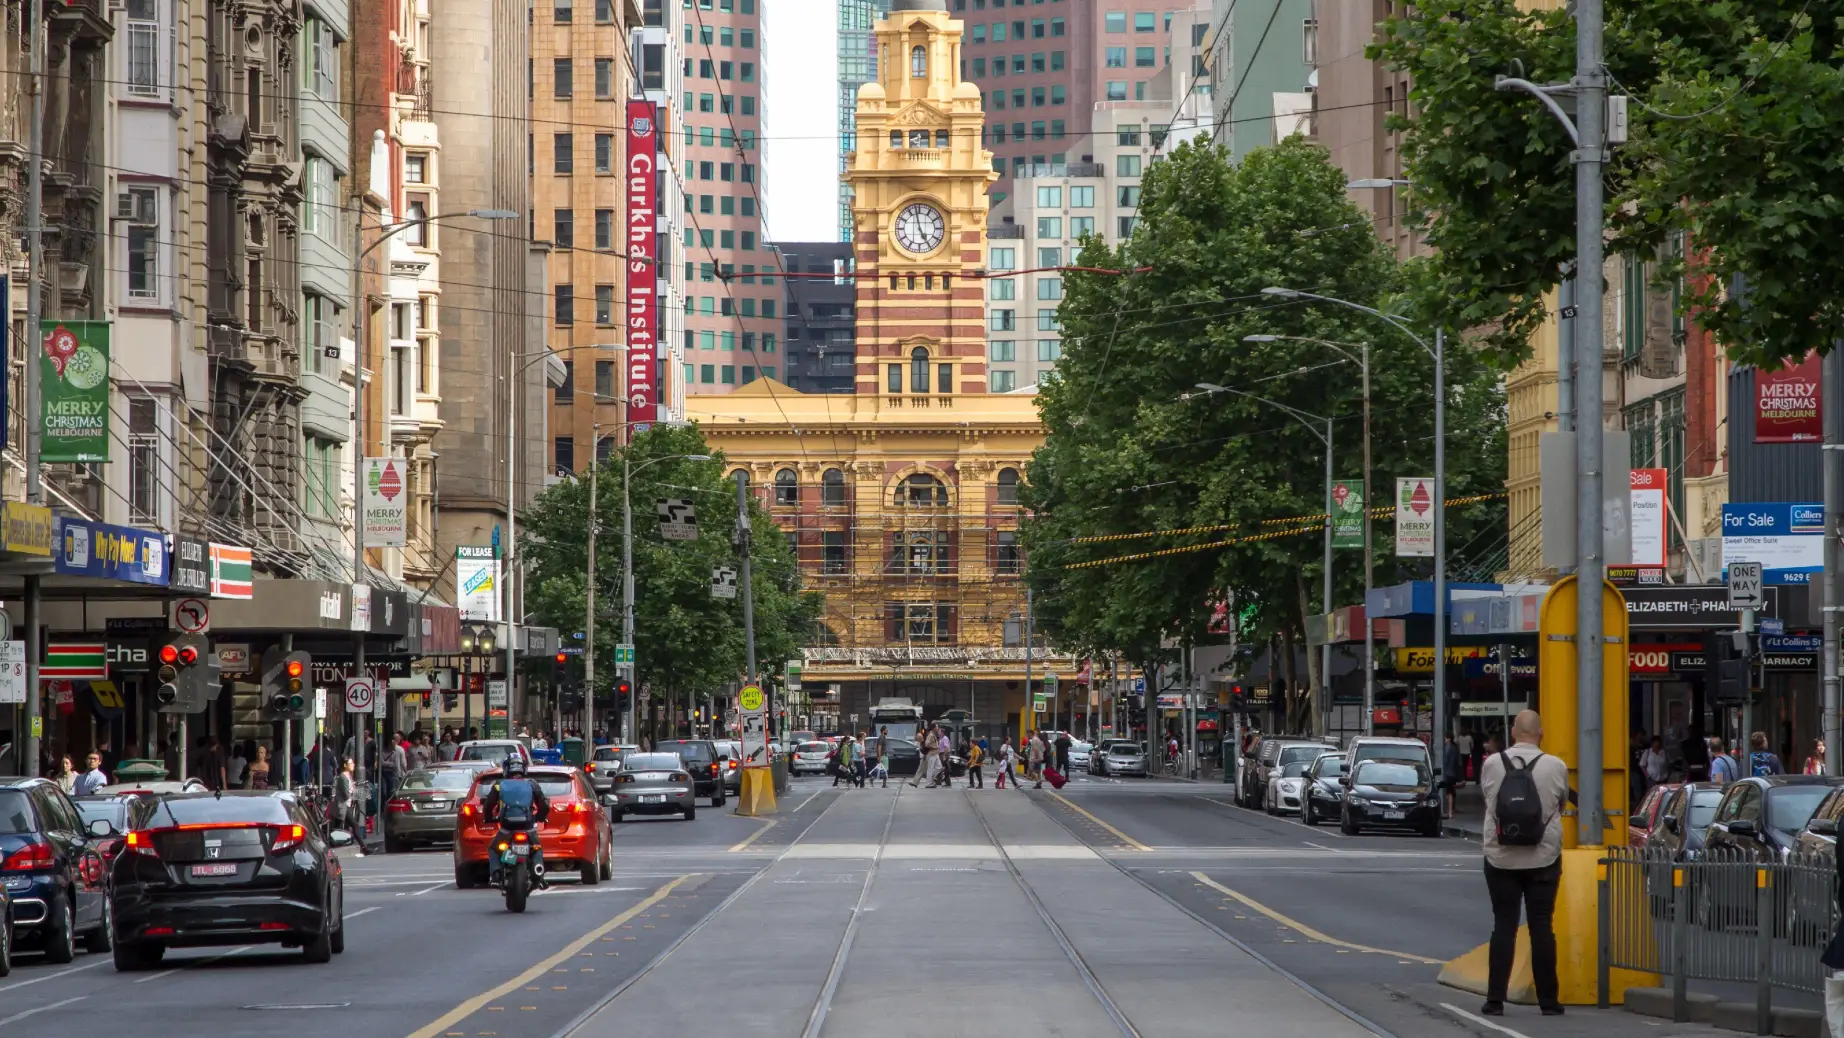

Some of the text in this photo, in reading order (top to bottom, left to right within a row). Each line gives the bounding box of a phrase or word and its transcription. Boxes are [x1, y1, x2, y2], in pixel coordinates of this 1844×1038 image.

[630, 153, 653, 408] Gurkhas Institute
[328, 349, 337, 357] 13
[1761, 383, 1817, 397] MERRY
[47, 401, 104, 415] MERRY
[1760, 398, 1817, 410] CHRISTMAS
[1761, 410, 1817, 418] MELBOURNE
[45, 416, 103, 428] CHRISTMAS
[47, 428, 103, 436] MELBOURNE
[1630, 471, 1652, 485] Sale
[1633, 501, 1657, 509] Position
[367, 509, 402, 518] MERRY
[1795, 510, 1822, 519] Colliers
[1724, 513, 1774, 526] For Sale
[1400, 522, 1431, 530] MERRY
[95, 530, 107, 568] Why
[108, 533, 120, 570] Pay
[458, 547, 492, 557] FOR LEASE
[1733, 567, 1757, 577] ONE
[1784, 573, 1804, 581] 9629
[465, 570, 488, 592] LEASED
[1732, 581, 1758, 590] WAY
[1626, 601, 1688, 612] ELIZABETH
[1772, 637, 1821, 646] Lt Collins St
[221, 650, 244, 660] AFL
[1628, 652, 1669, 667] FOOD
[350, 688, 369, 701] 40
